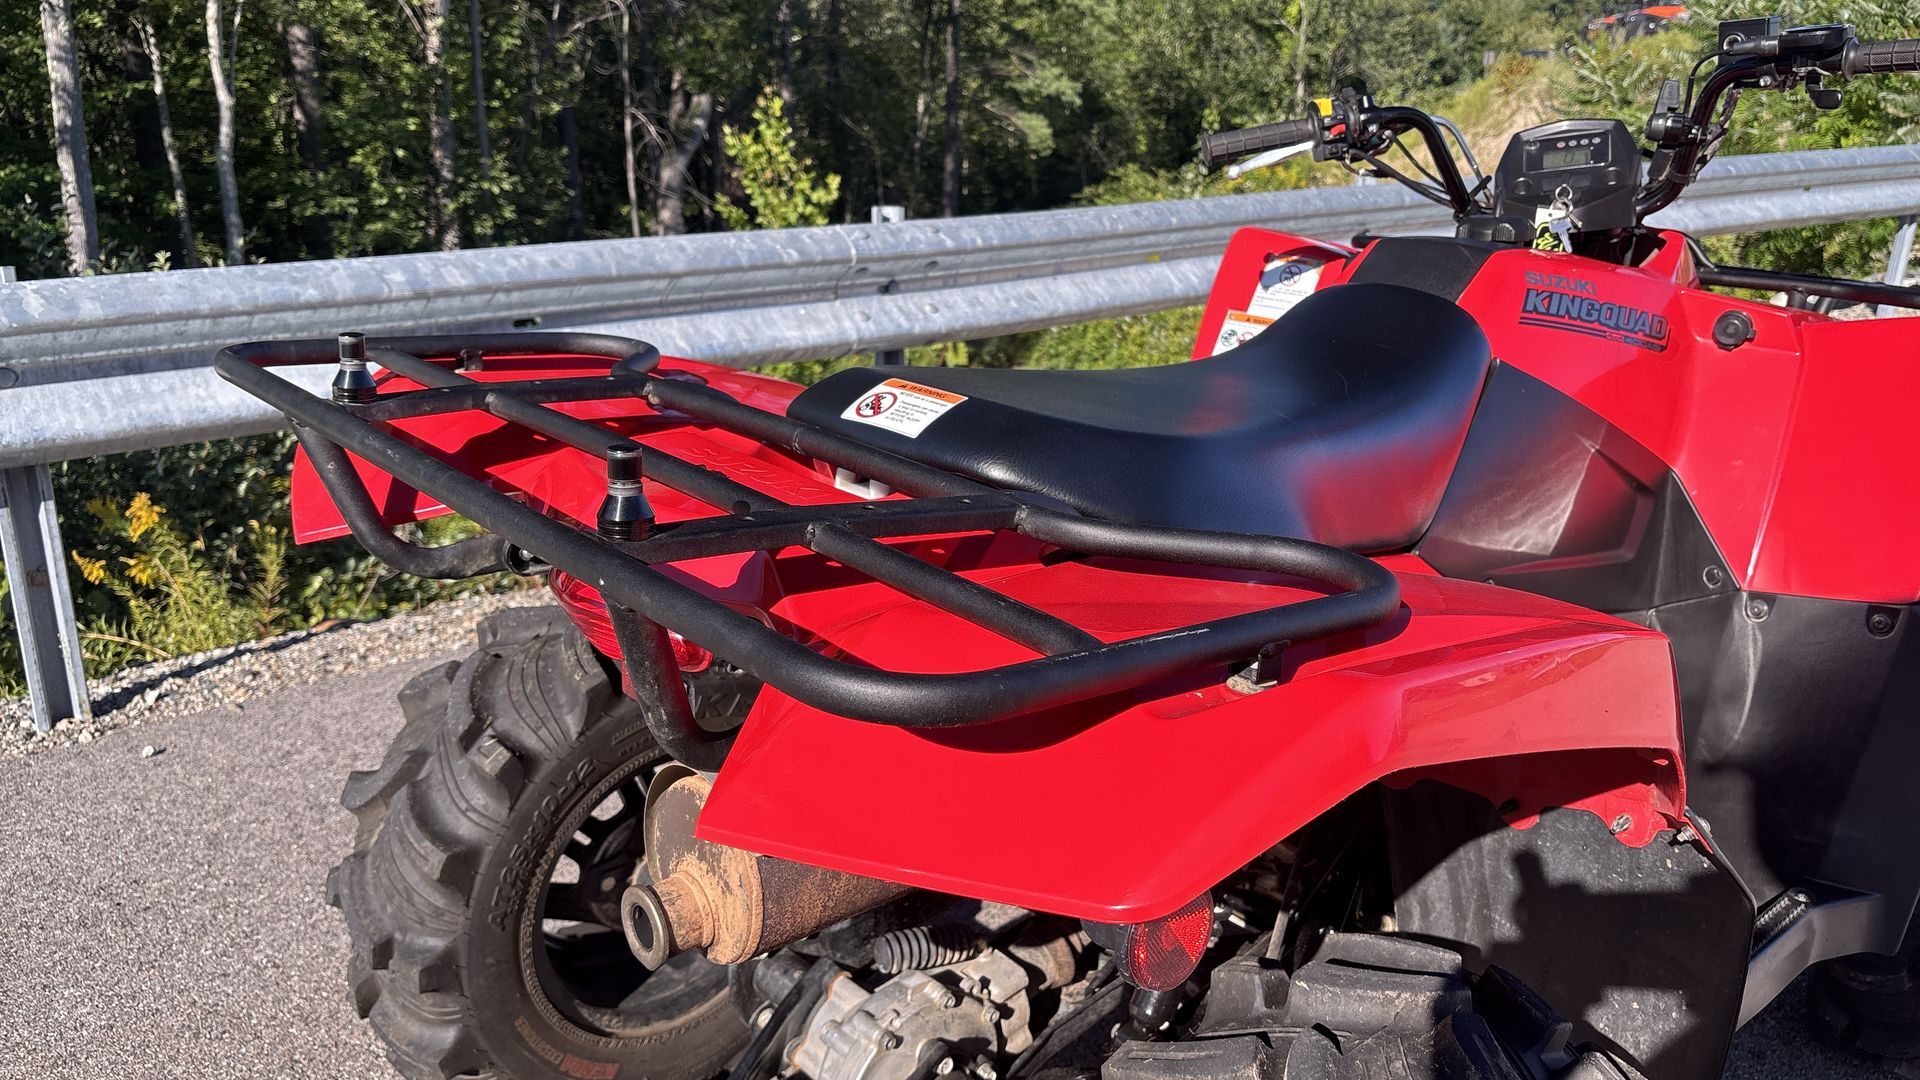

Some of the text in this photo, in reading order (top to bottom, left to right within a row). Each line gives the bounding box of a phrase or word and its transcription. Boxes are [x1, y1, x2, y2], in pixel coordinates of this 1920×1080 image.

[1525, 271, 1597, 295] SUZUKI
[1523, 288, 1669, 341] KINGQUAD
[910, 384, 948, 399] WARNING
[683, 448, 833, 500] SUZUKI
